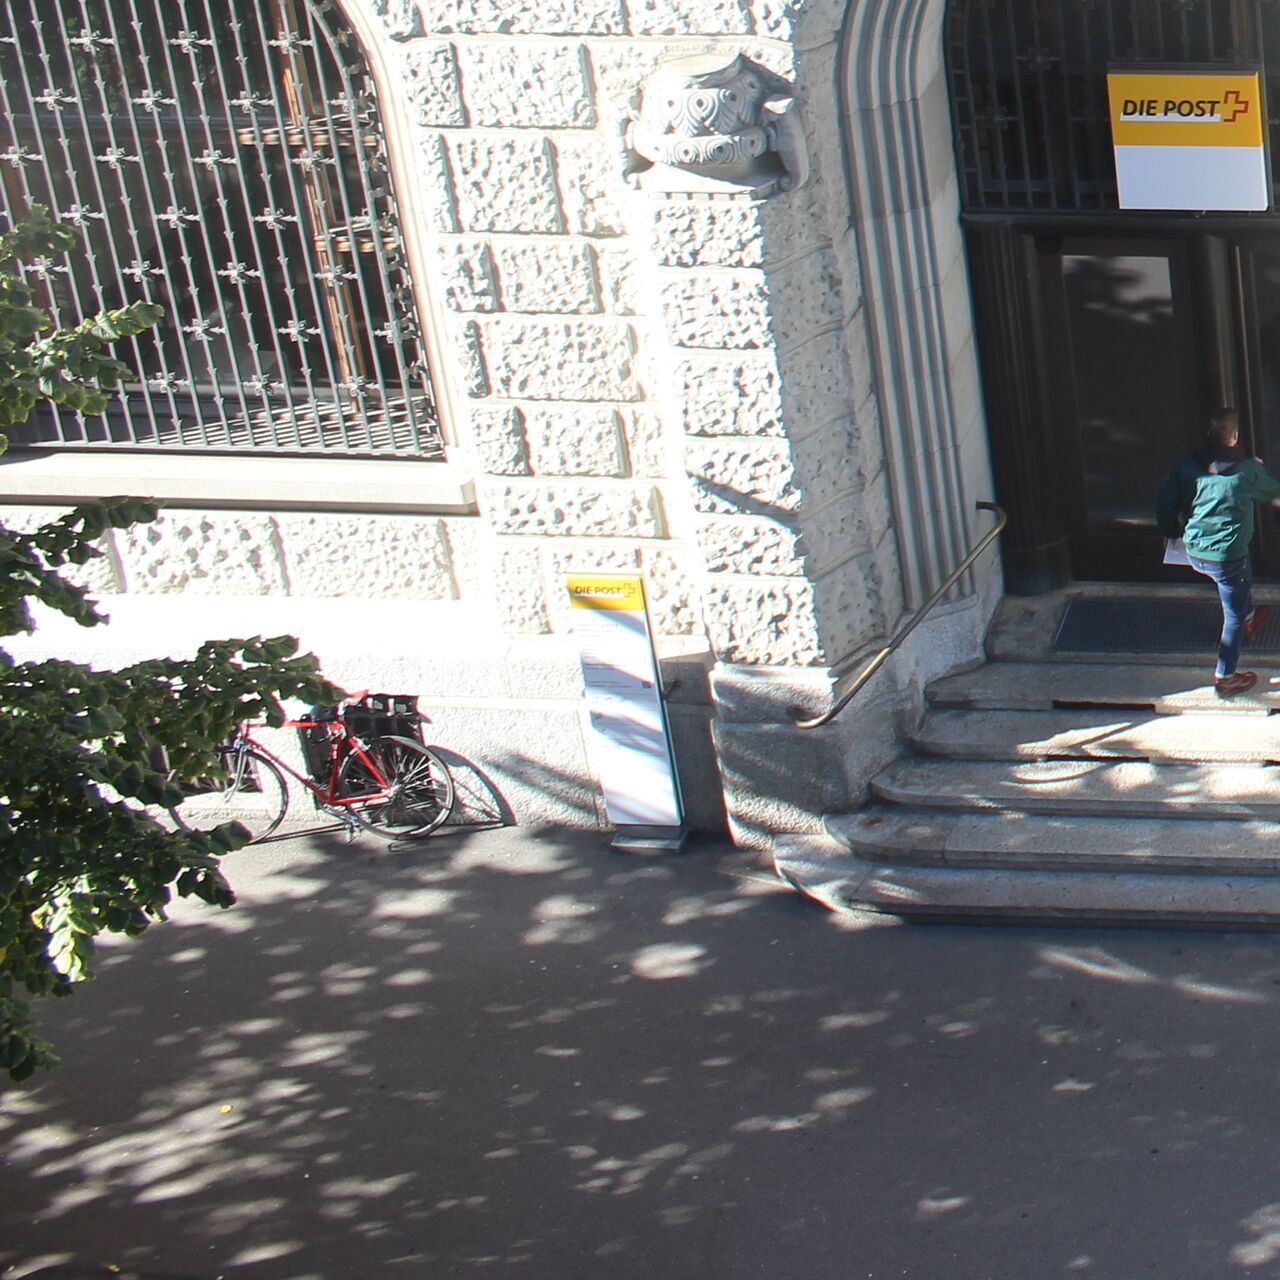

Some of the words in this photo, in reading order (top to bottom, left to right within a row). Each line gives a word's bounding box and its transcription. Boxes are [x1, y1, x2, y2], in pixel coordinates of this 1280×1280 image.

[1122, 99, 1158, 117] DIE
[1163, 100, 1220, 117] POST
[574, 586, 592, 595] DIE
[594, 586, 621, 595] POST
